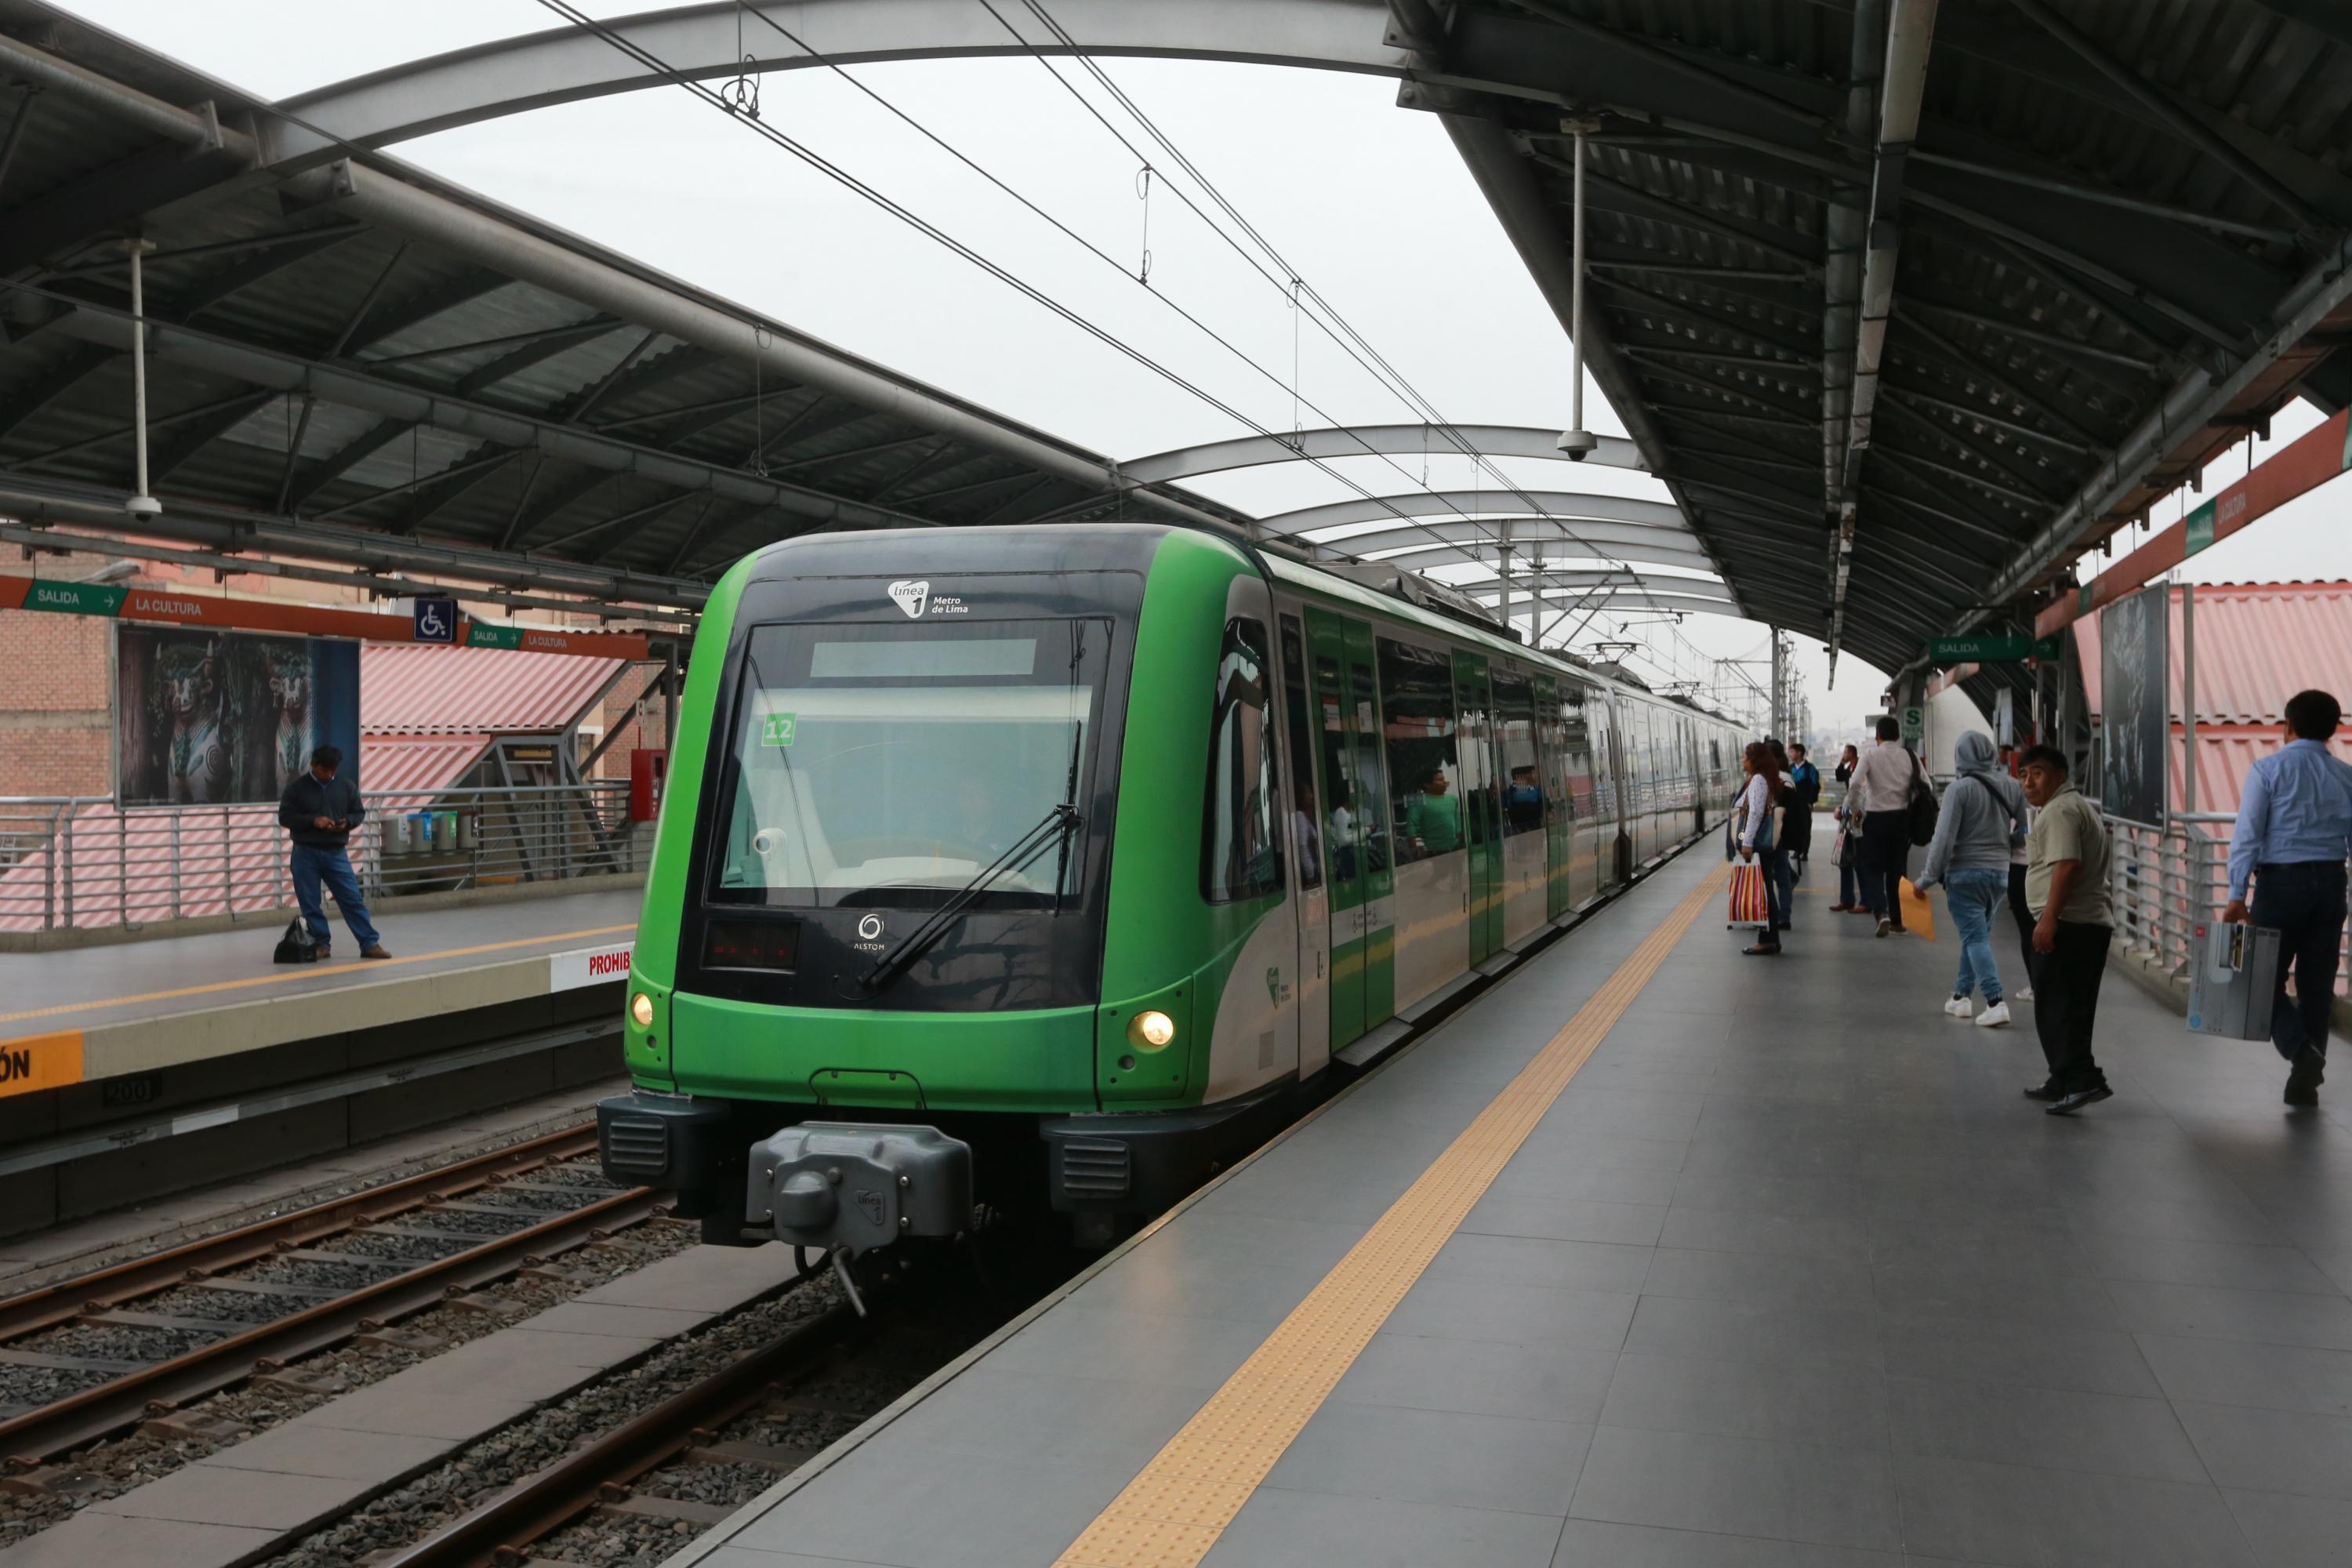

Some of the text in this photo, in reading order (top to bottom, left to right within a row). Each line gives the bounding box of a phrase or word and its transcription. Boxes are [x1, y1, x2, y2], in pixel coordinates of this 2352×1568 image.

[38, 589, 79, 604] SALIDA
[933, 596, 961, 604] Metro
[136, 597, 201, 615] LA CULTURA
[912, 597, 923, 615] 1
[474, 630, 498, 641] SALIDA
[528, 635, 568, 648] LA CULTURA
[1938, 643, 1980, 654] SALIDA
[1906, 710, 1920, 725] S
[767, 719, 792, 739] 12
